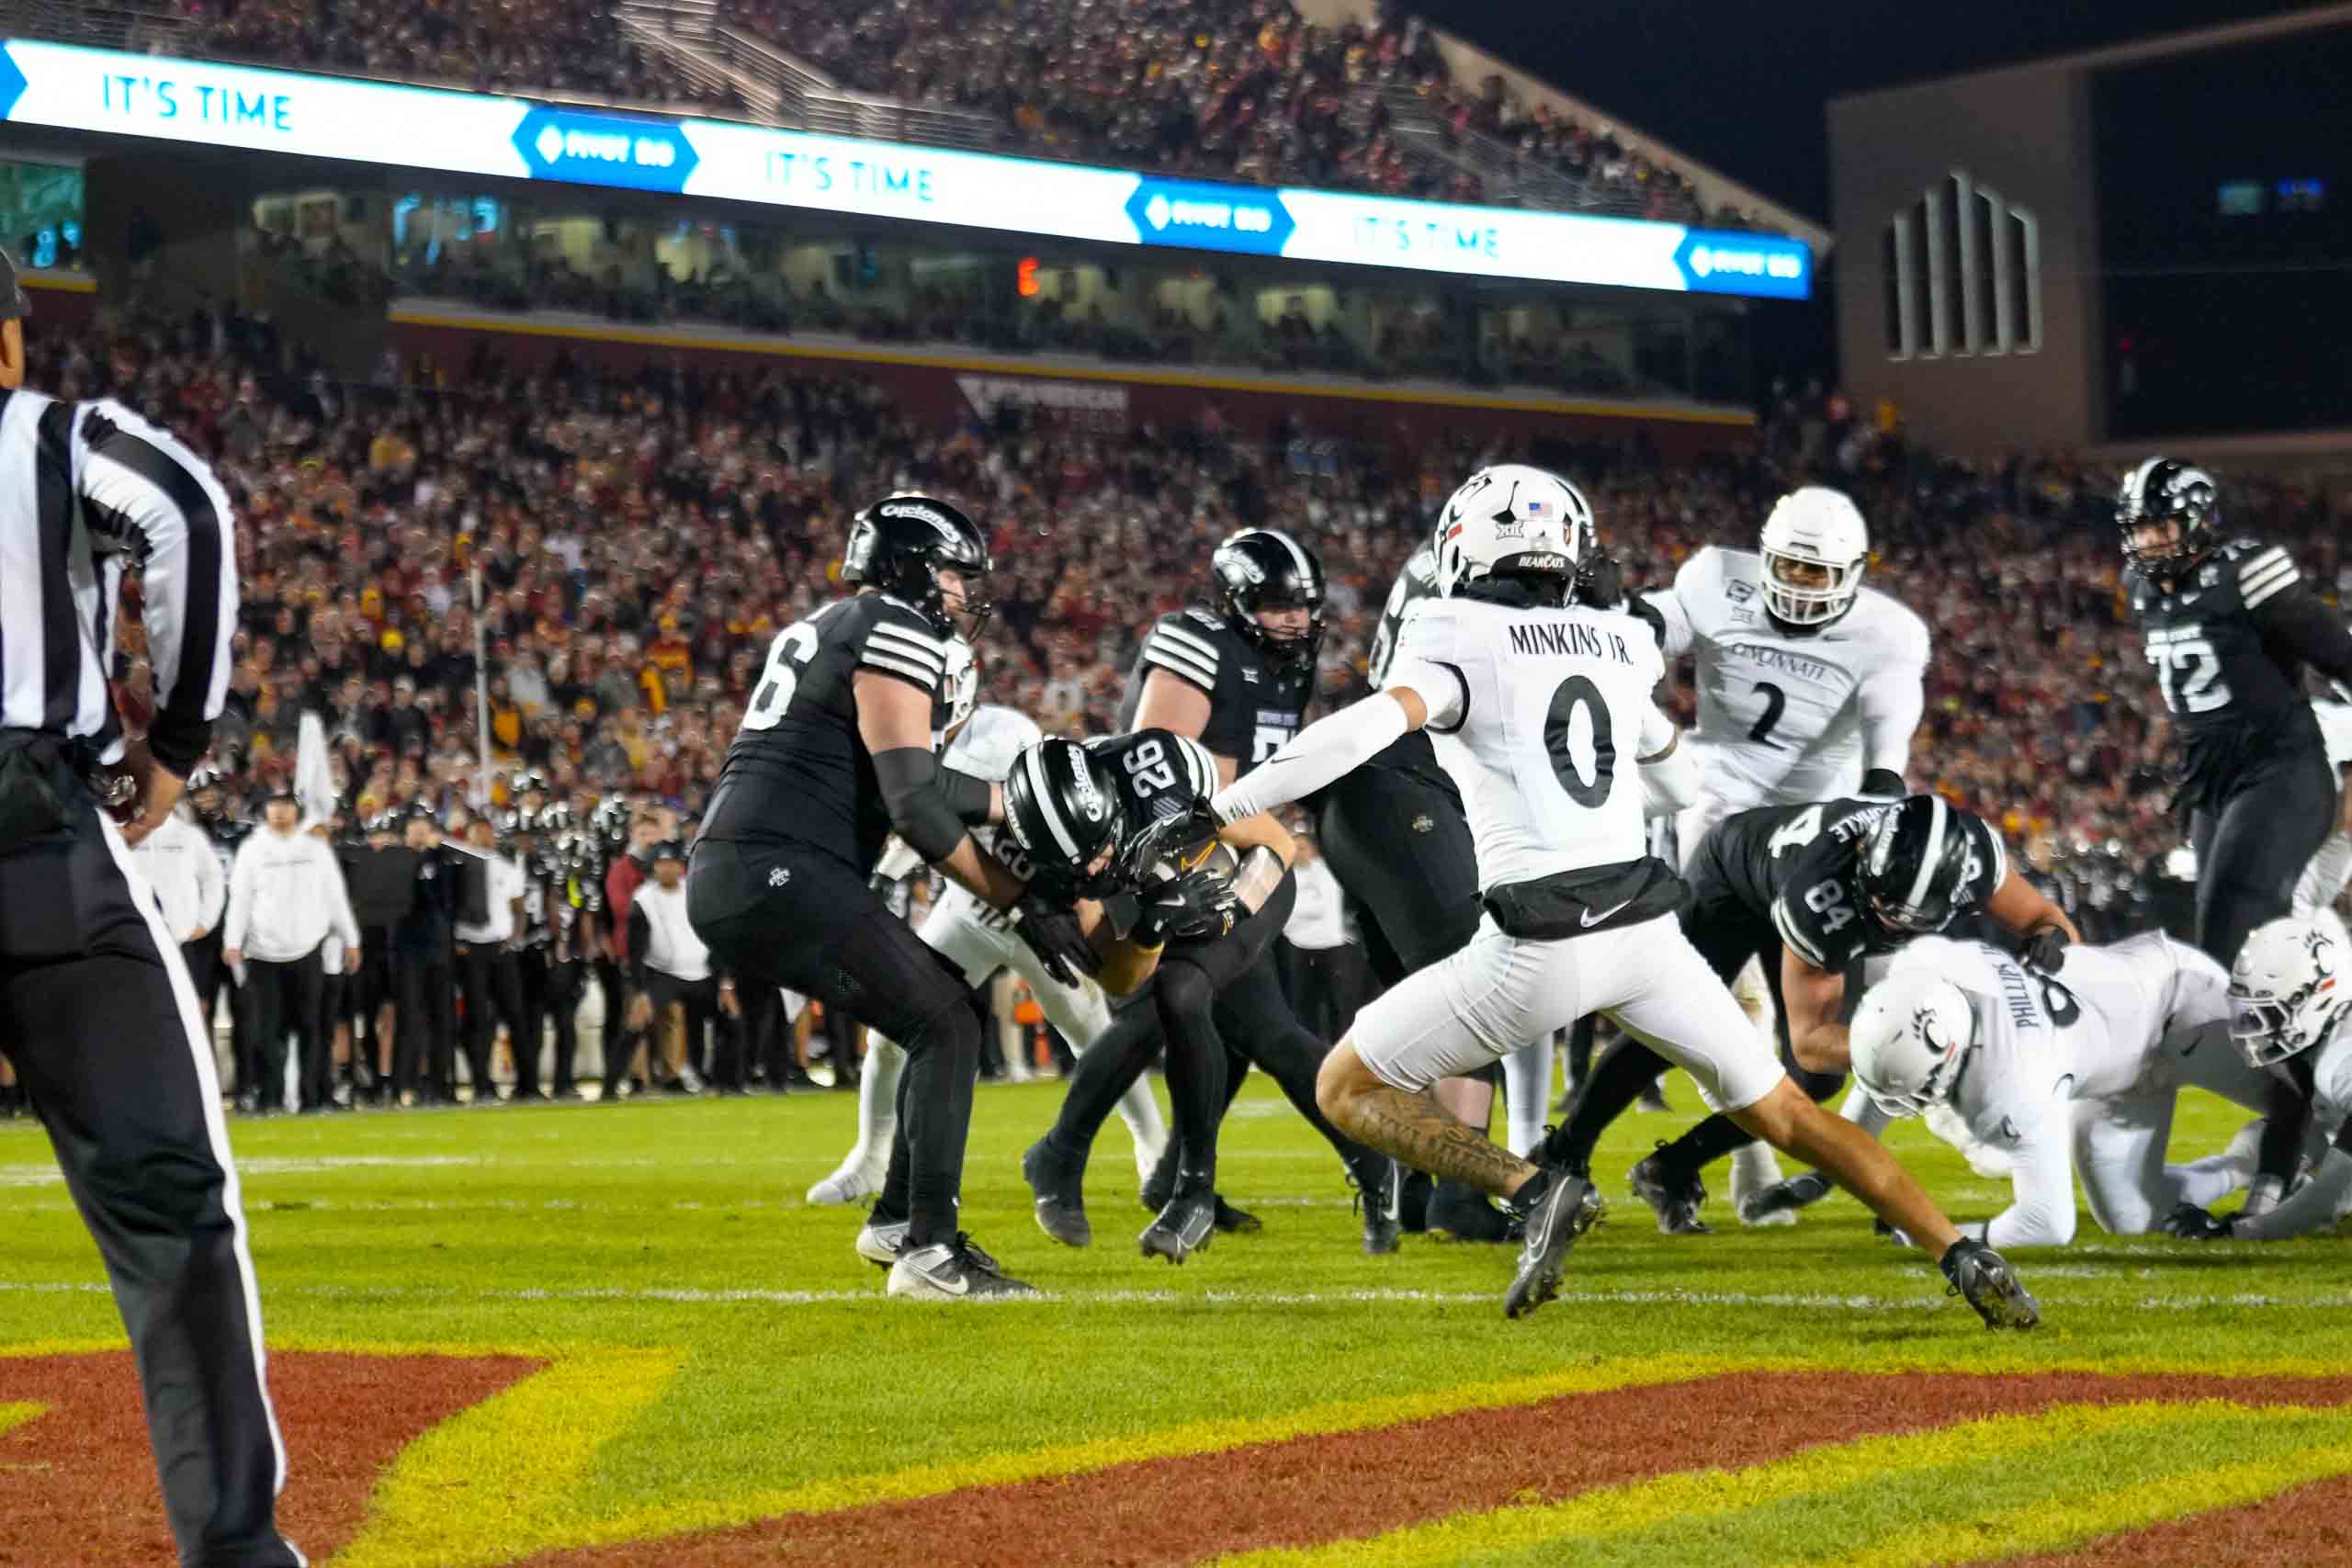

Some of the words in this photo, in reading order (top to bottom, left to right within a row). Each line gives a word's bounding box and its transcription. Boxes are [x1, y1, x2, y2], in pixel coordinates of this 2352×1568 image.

[103, 73, 178, 118] IT'S
[194, 85, 293, 131] TIME
[764, 151, 832, 191] IT'S
[849, 161, 933, 203] TIME
[1426, 222, 1499, 260] TIME
[880, 504, 961, 544] Cyclones
[1509, 623, 1602, 659] MINKINS
[2144, 641, 2232, 714] 72
[1544, 674, 1617, 809] 0
[1750, 681, 1788, 751] 2
[1123, 739, 1177, 799] 26
[1804, 878, 1855, 935] 84
[1998, 962, 2041, 1028] PHILLIPS
